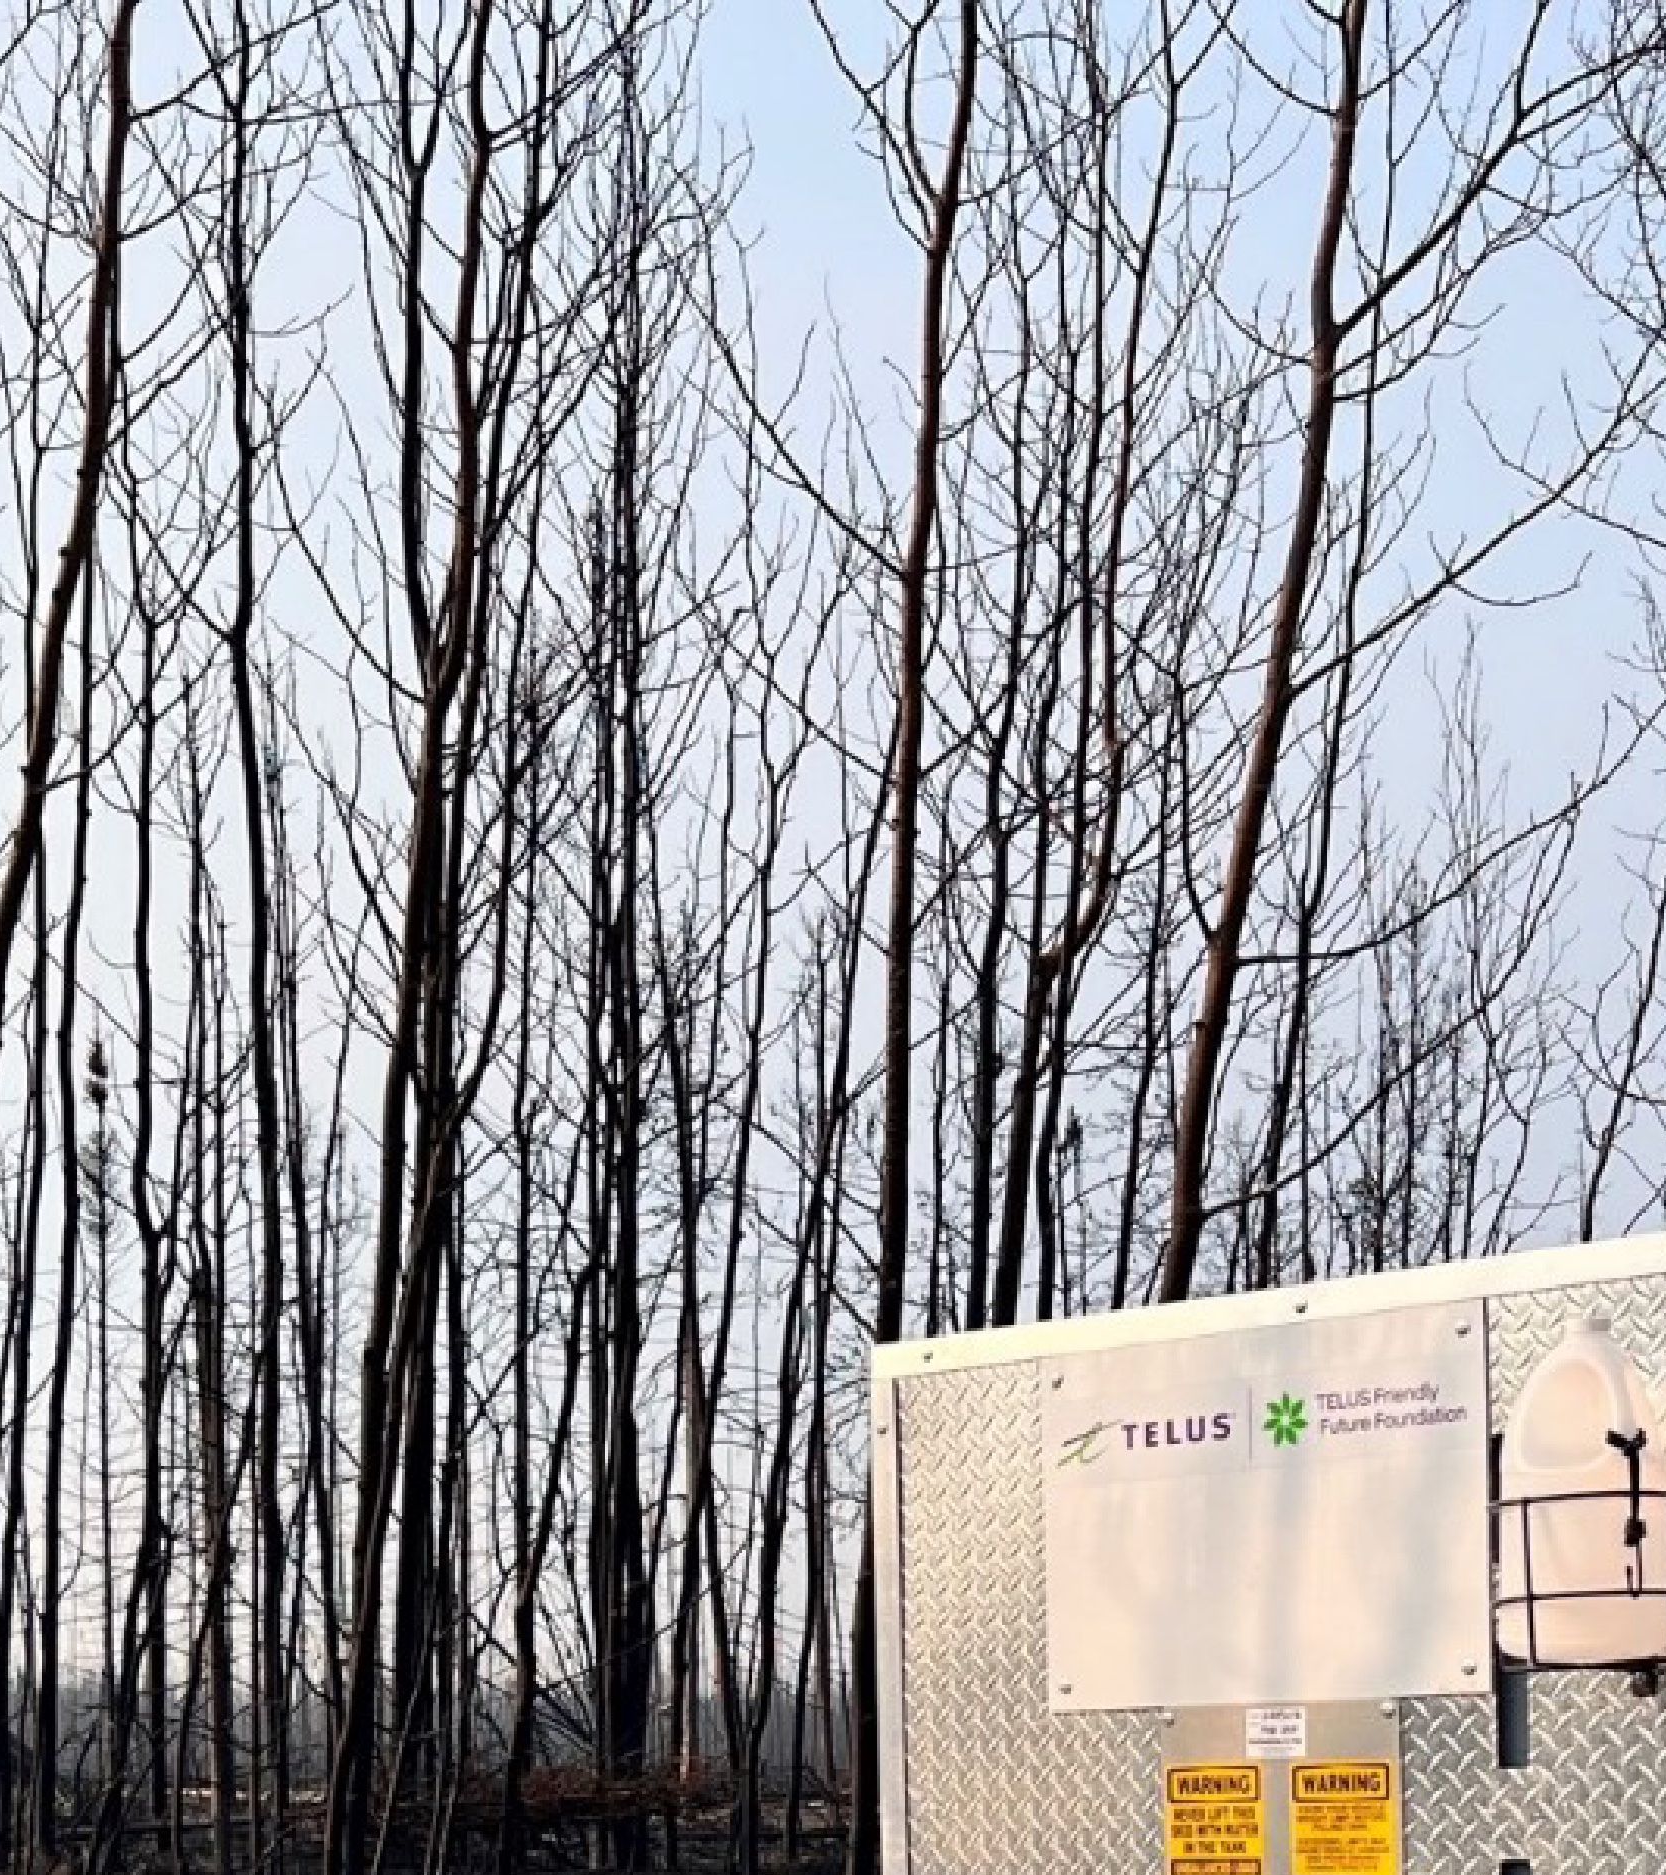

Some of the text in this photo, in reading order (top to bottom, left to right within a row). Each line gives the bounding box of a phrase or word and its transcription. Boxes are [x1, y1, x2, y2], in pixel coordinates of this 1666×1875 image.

[1315, 1382, 1439, 1410] TELUS Friendly
[1121, 1412, 1232, 1450] TELUS
[1320, 1406, 1467, 1436] Future Foundation
[1177, 1774, 1250, 1796] WARNING
[1301, 1771, 1381, 1794] WARNING
